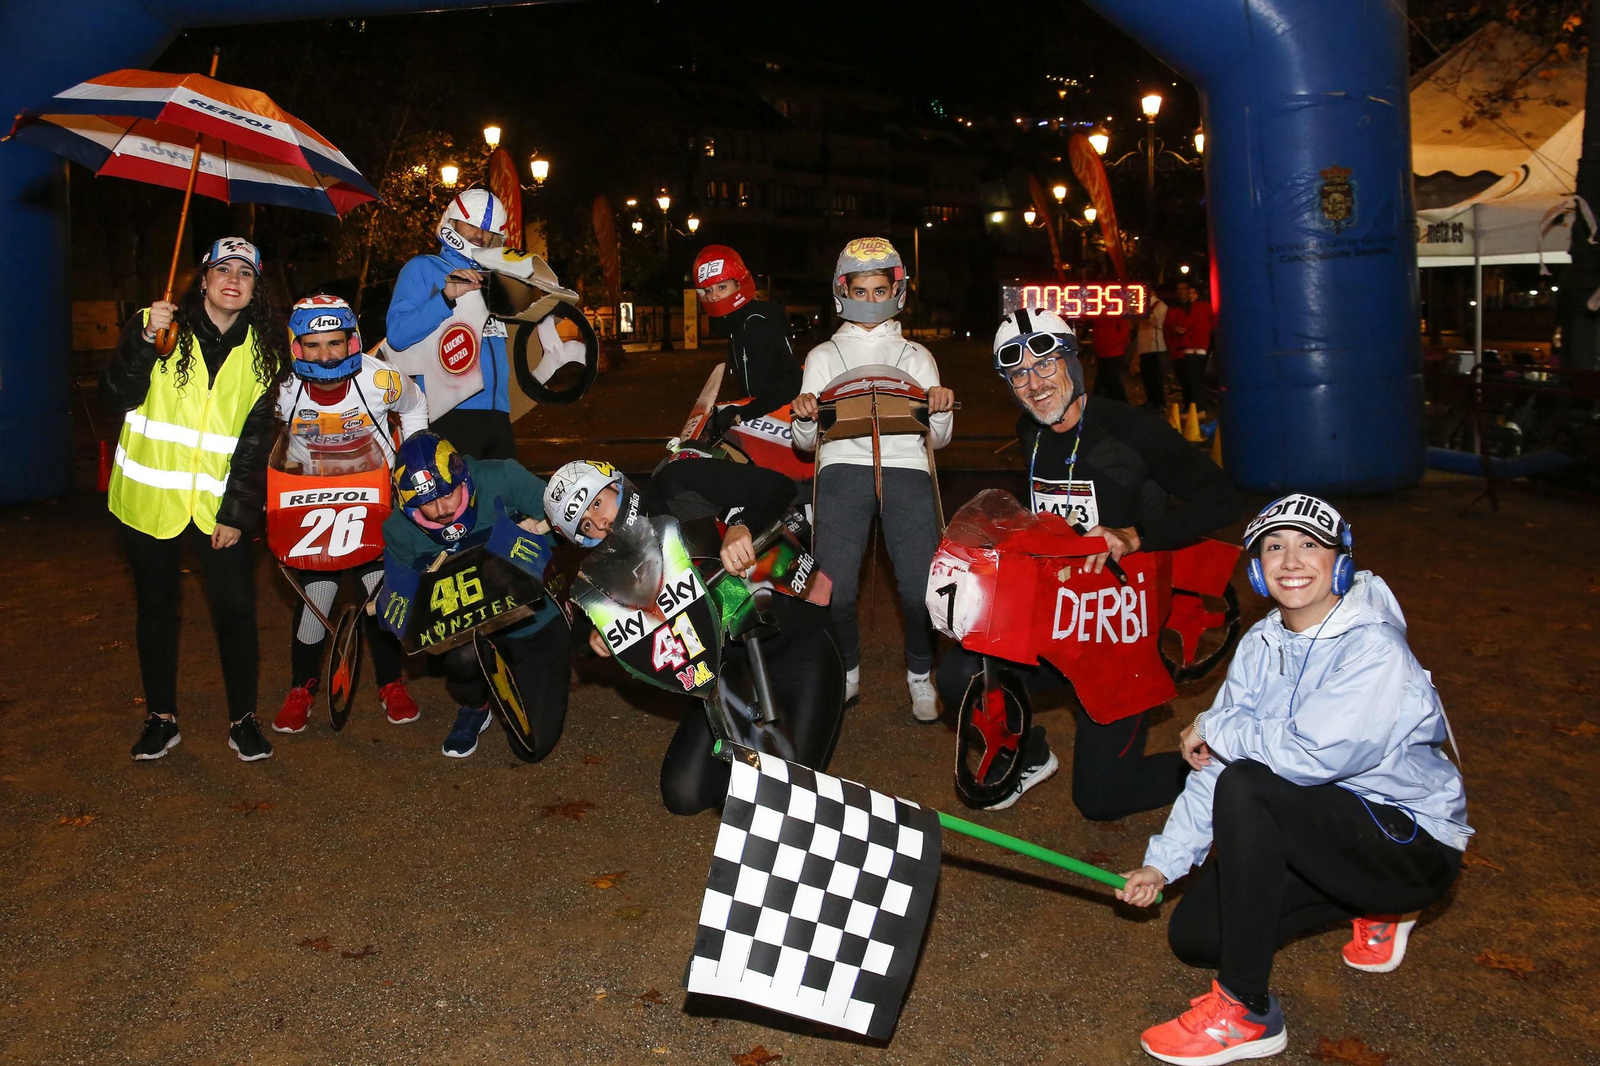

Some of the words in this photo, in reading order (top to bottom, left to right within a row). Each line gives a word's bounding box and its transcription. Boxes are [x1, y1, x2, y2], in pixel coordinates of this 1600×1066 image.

[188, 98, 273, 131] REPSOL
[443, 230, 462, 248] Arai
[311, 317, 341, 330] Arai
[443, 333, 466, 354] LUCKY
[448, 348, 469, 366] 2020
[289, 491, 370, 506] REPSOL
[414, 480, 436, 494] agv
[626, 493, 640, 526] aprilia
[288, 505, 368, 558] 26
[445, 527, 465, 540] agv
[790, 552, 815, 594] aprilia
[430, 565, 485, 617] 46
[658, 573, 698, 614] sky
[606, 610, 645, 649] sky
[652, 611, 706, 672] 41
